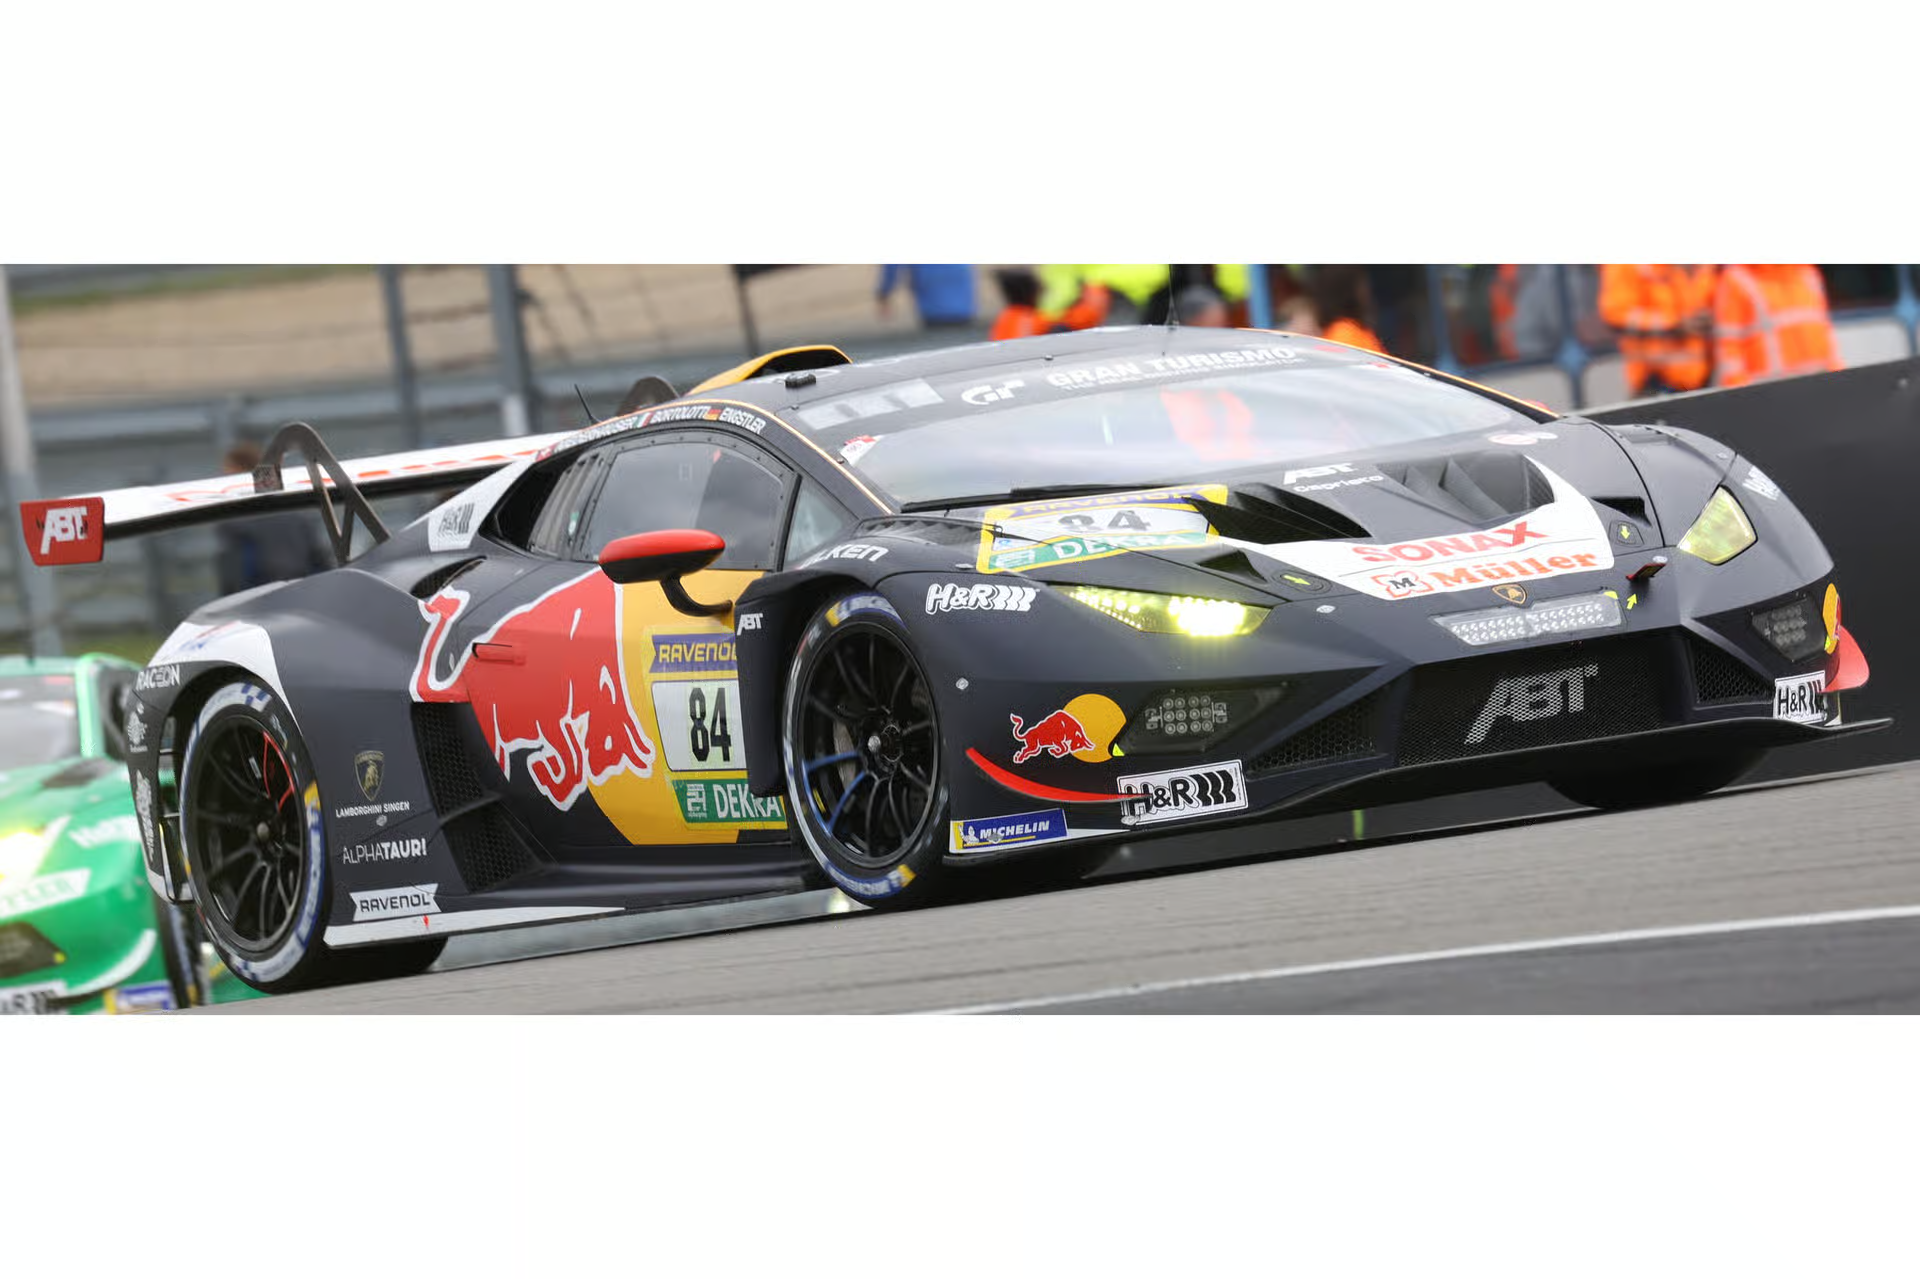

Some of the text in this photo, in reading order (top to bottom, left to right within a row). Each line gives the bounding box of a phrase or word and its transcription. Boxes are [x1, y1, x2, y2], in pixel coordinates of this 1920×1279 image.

[1045, 362, 1140, 388] GRAN
[1144, 347, 1298, 373] TURISMO
[719, 406, 767, 435] ENGSTLER
[1283, 463, 1357, 485] ABT
[40, 506, 88, 554] ABT
[1351, 520, 1551, 562] SONAX
[1053, 534, 1192, 560] DEKRA
[1429, 551, 1598, 588] Müller
[926, 583, 1006, 614] H&R
[736, 613, 763, 636] ABT
[1464, 663, 1599, 745] ABT
[1777, 683, 1813, 716] H&R
[688, 687, 732, 762] 84
[335, 801, 411, 819] LAMBORGHINI SINGEN
[1121, 775, 1204, 816] H&R
[979, 819, 1051, 841] MICHELIN
[359, 893, 432, 914] RAVENOL
